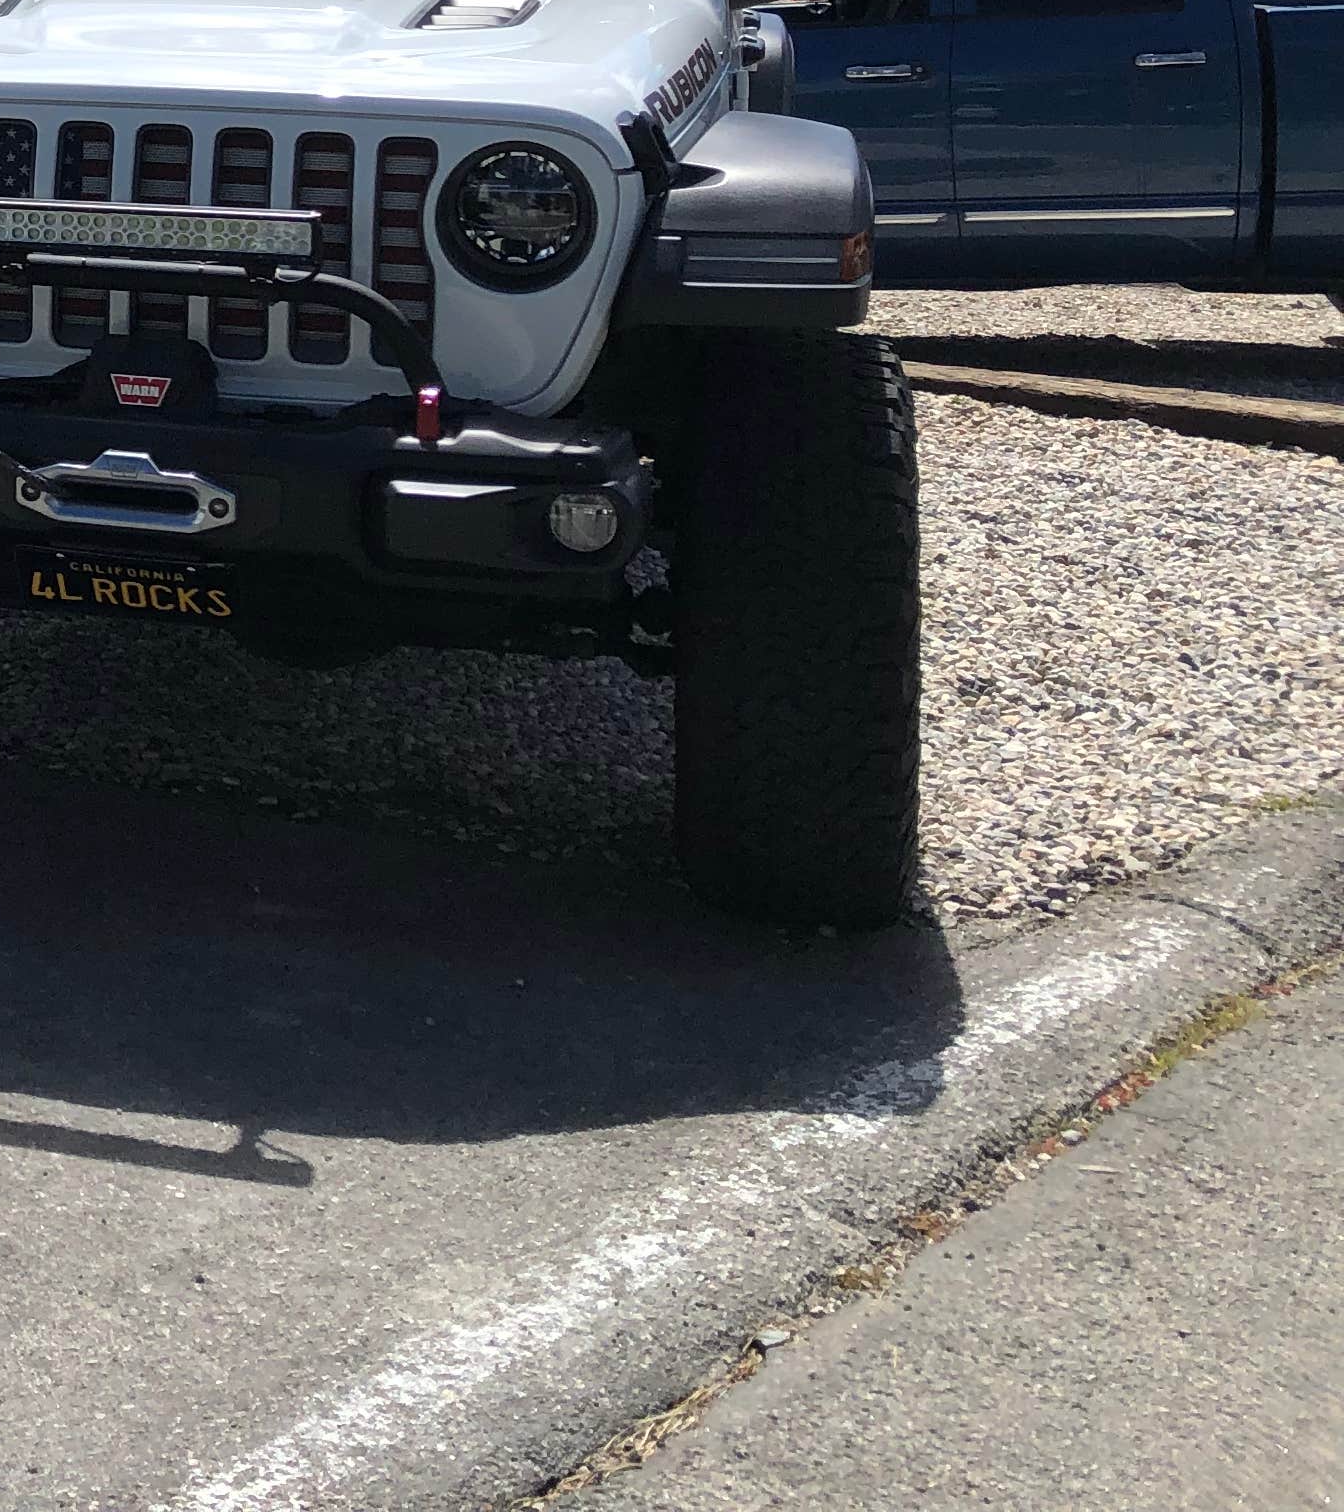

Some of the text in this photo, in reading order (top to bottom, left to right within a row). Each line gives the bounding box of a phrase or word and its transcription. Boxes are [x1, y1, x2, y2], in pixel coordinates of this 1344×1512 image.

[643, 37, 718, 131] RUBICON
[120, 383, 160, 398] WARN
[69, 561, 185, 582] CALIFORNIA
[31, 571, 232, 617] 4L ROCKS
